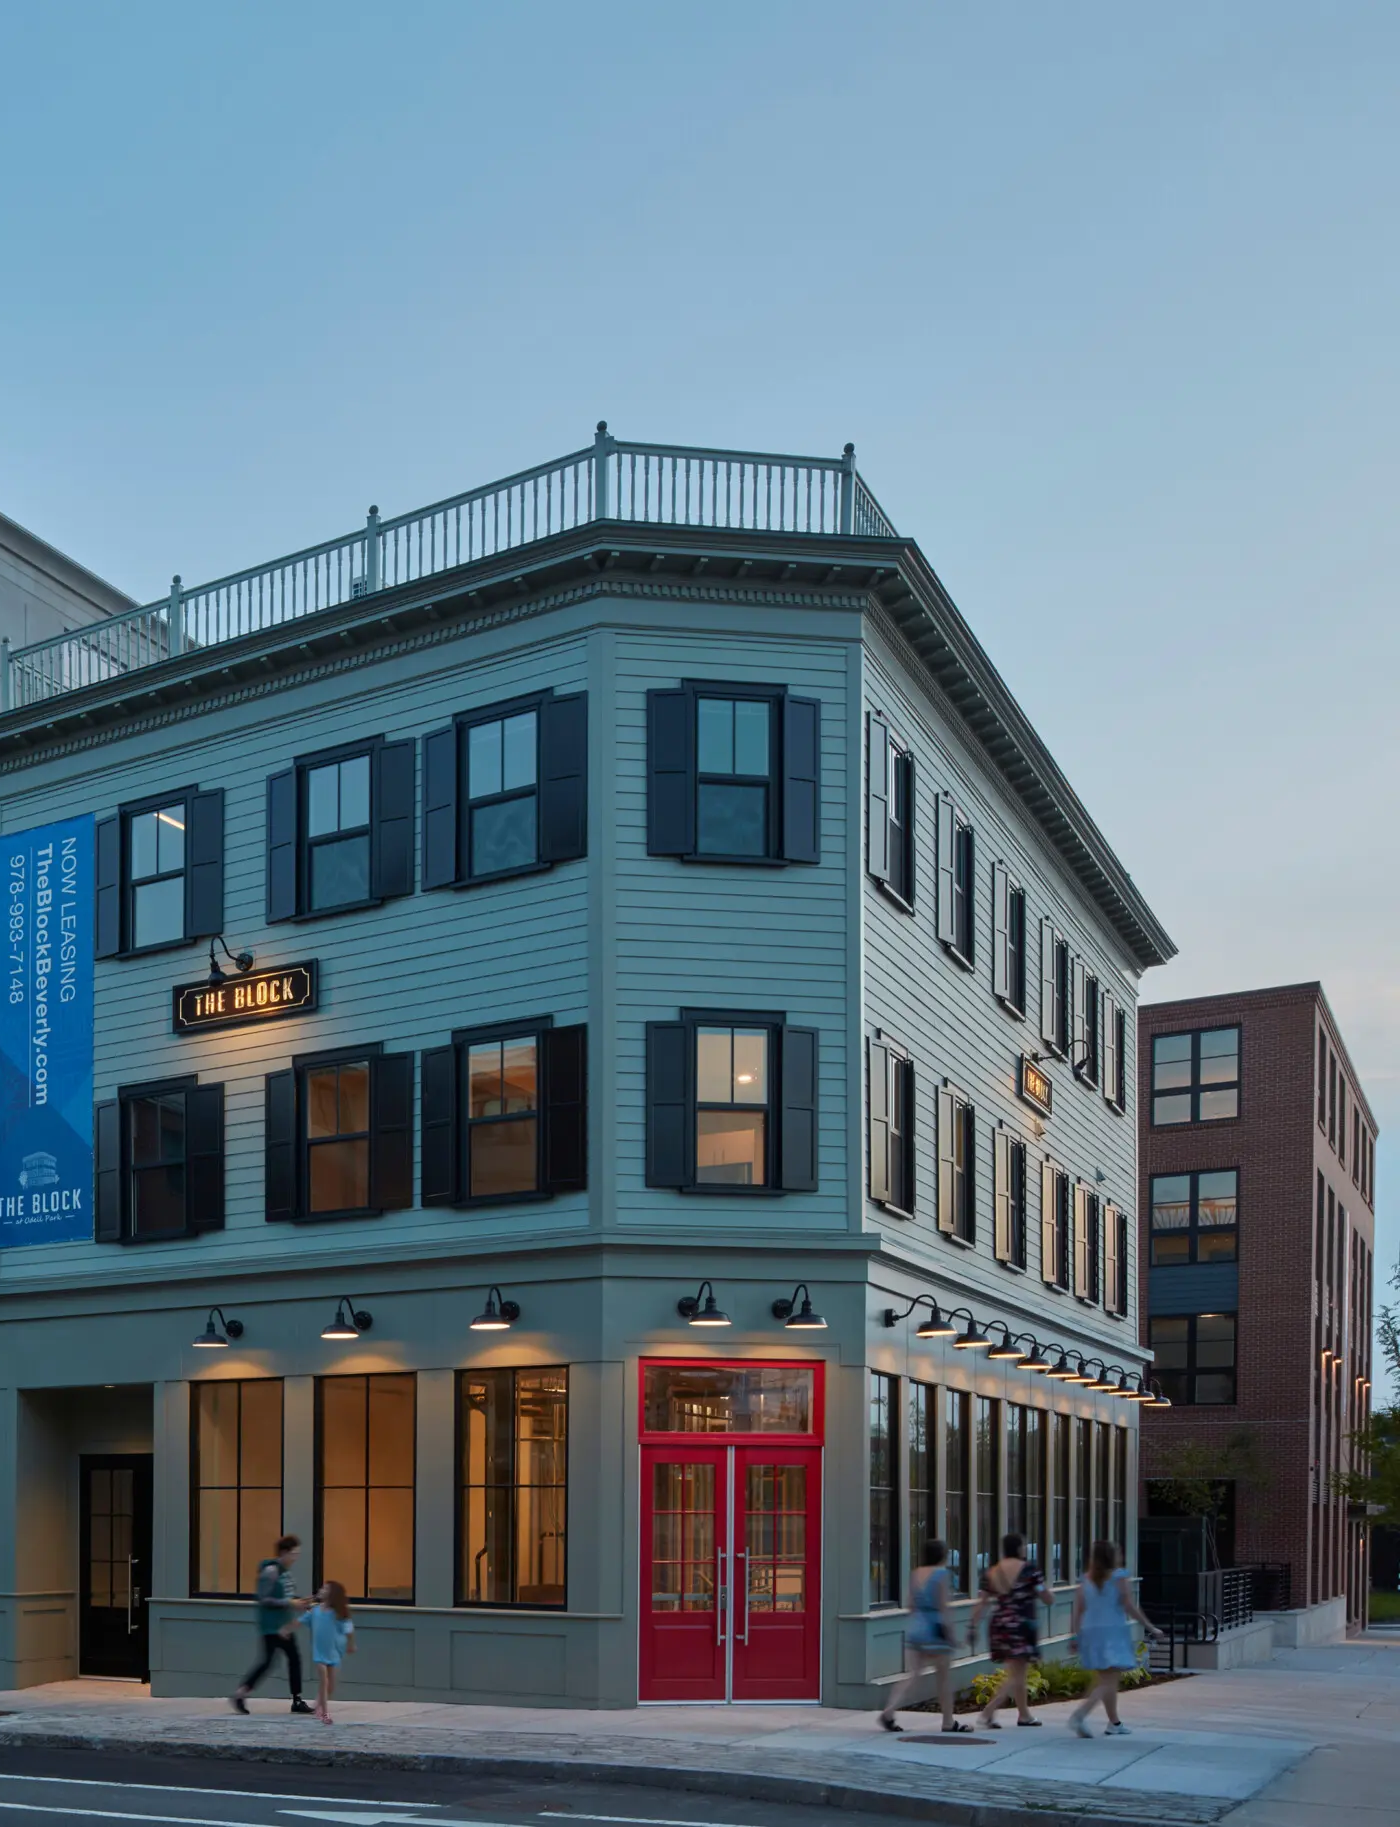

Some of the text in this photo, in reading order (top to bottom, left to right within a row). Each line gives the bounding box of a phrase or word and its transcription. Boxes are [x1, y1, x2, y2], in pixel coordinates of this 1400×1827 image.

[9, 855, 25, 1004] 978-993-7148
[60, 837, 77, 1003] NOW LEASING
[33, 843, 53, 1106] TheBlockBeverly.com
[194, 976, 294, 1017] THE BLOCK
[32, 1188, 82, 1214] BLOCK
[44, 1213, 62, 1223] Park
